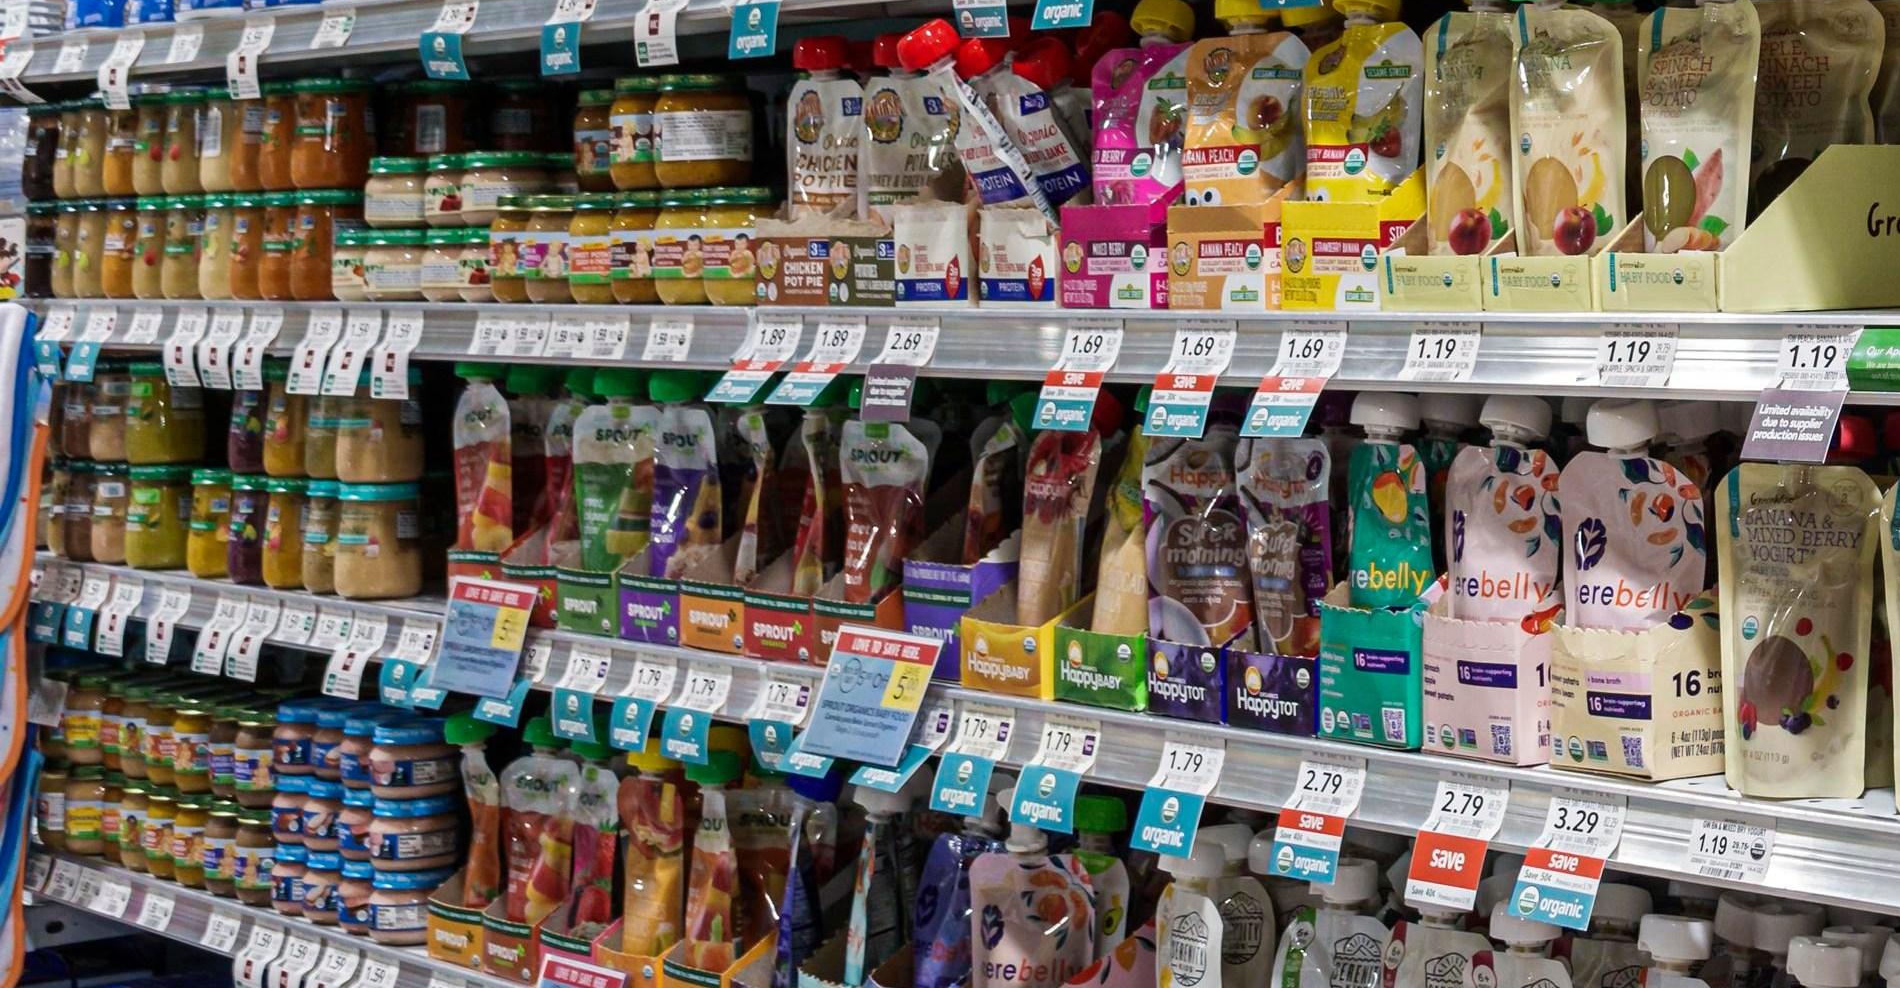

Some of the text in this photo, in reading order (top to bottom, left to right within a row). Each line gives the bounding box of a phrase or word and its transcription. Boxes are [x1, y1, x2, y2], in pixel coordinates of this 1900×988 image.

[890, 333, 921, 351] 2.69
[1071, 335, 1103, 354] 1.69
[1417, 338, 1456, 359] 1.19
[1789, 345, 1837, 368] 1.19
[1759, 404, 1789, 415] Limited
[1801, 529, 1862, 550] BERRY
[753, 622, 795, 641] SPROUT
[1672, 670, 1701, 697] 16
[1303, 770, 1343, 794] 2.79
[1553, 806, 1599, 833] 3.29
[1699, 834, 1727, 855] 1.19
